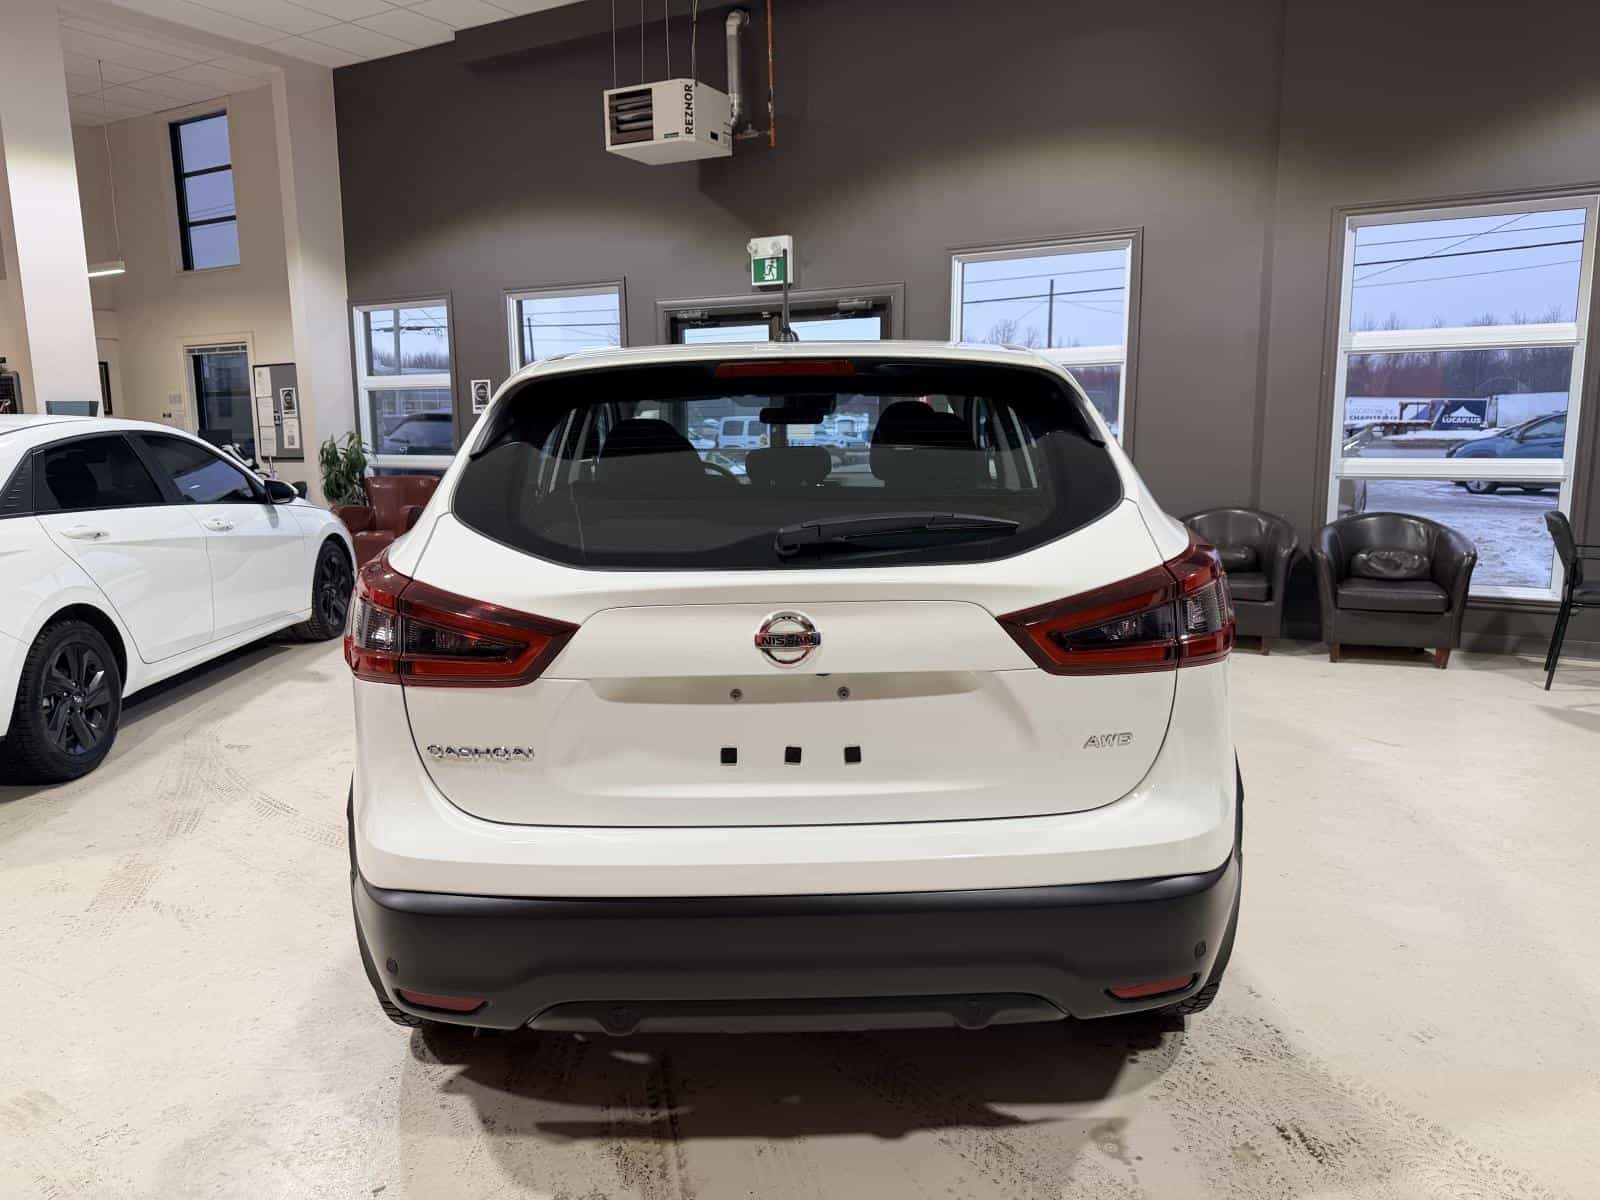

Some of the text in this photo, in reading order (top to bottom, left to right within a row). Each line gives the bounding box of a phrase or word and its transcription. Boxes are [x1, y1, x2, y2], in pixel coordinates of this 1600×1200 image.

[684, 83, 694, 135] REZNOR
[1442, 414, 1482, 424] LOCAPLUS
[759, 634, 817, 646] NISSAN
[1082, 732, 1133, 750] AWD
[427, 744, 535, 761] QASHQAI
